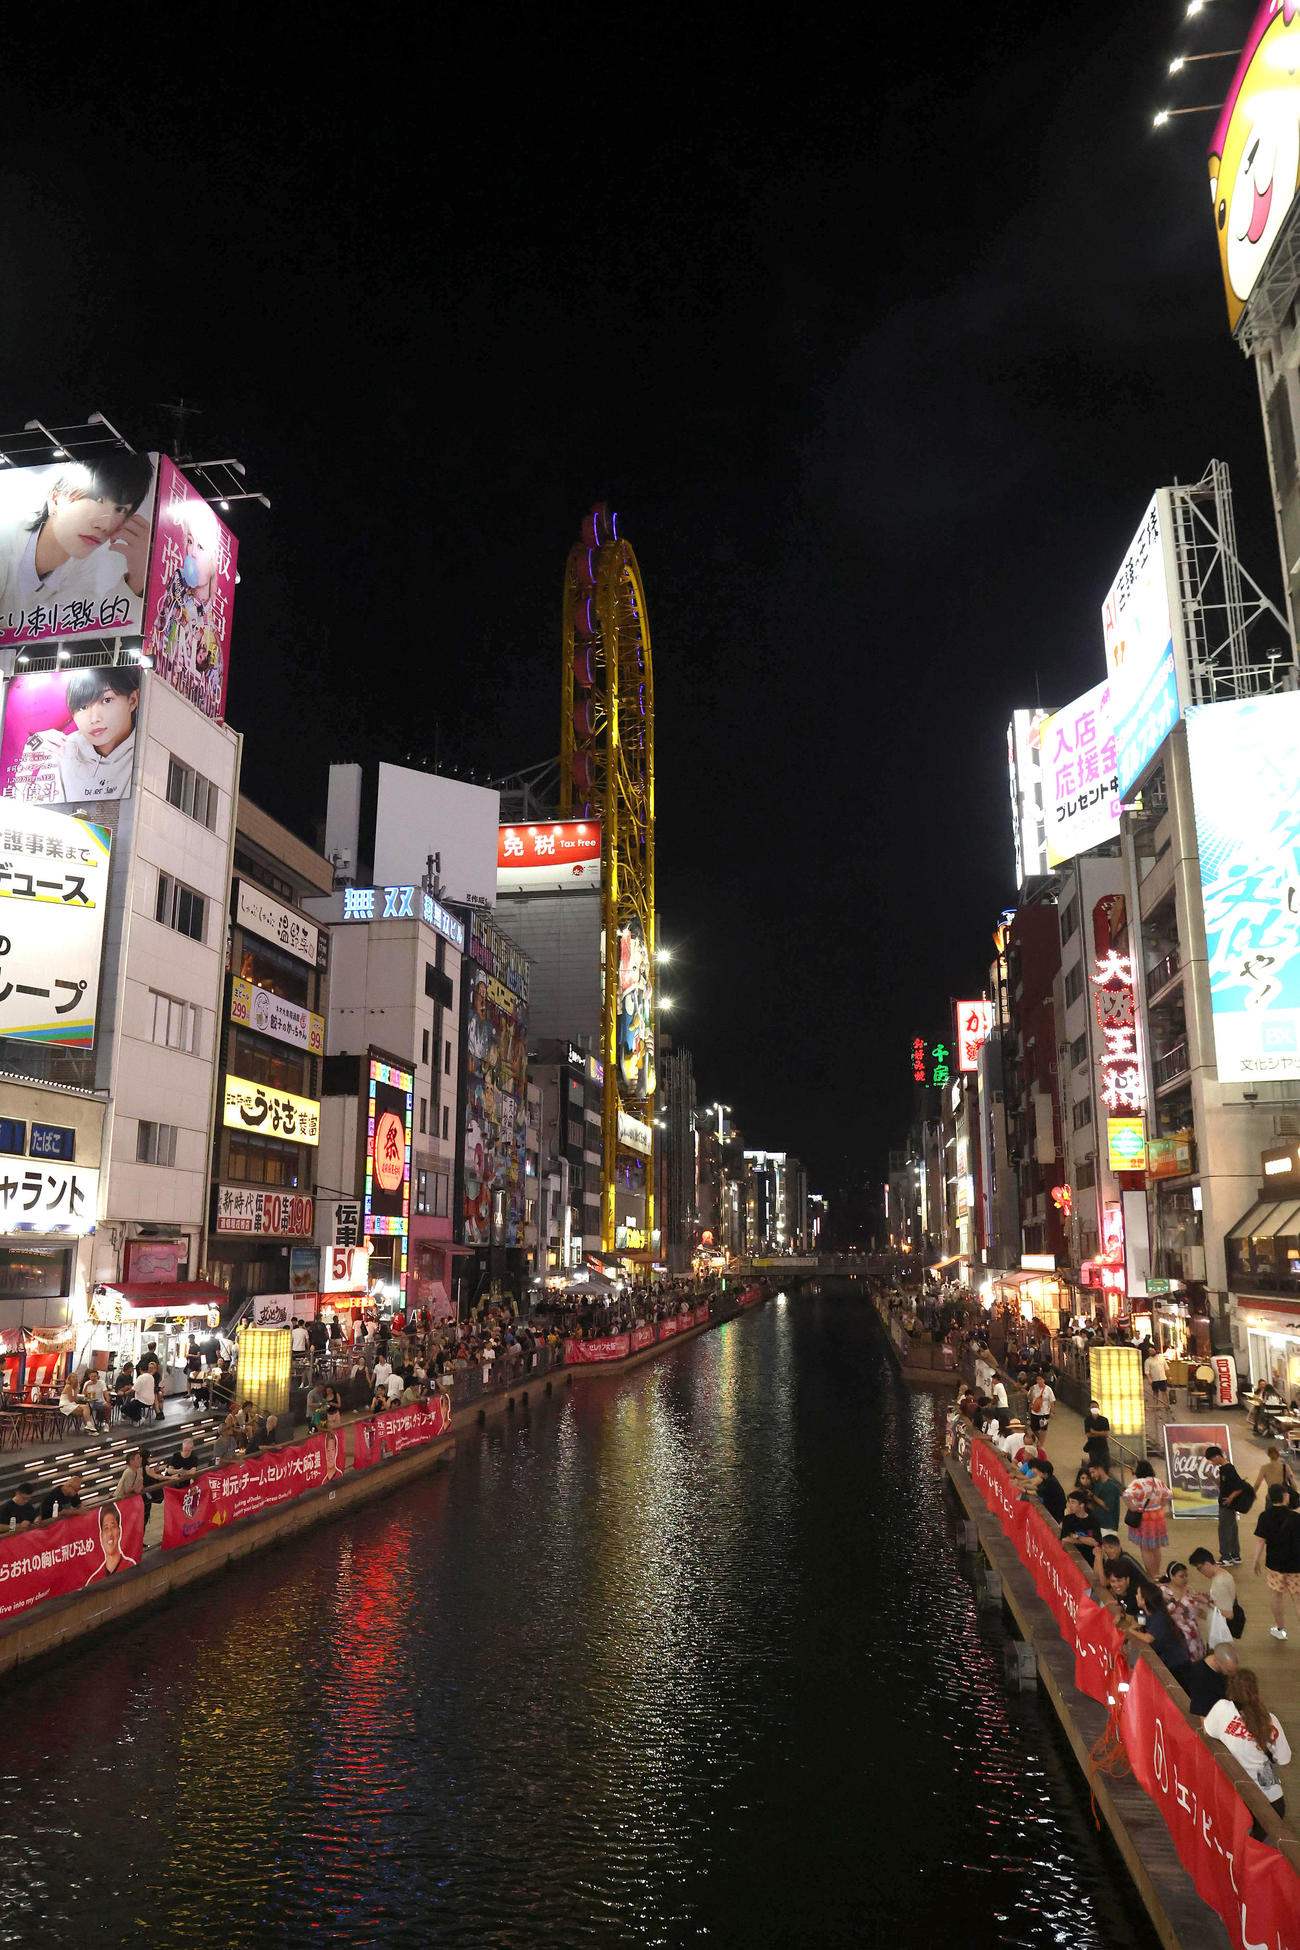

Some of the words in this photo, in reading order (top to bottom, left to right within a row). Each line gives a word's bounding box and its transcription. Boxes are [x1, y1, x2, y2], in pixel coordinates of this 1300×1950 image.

[212, 523, 232, 641] 最高
[1053, 710, 1095, 764] 入店
[1055, 735, 1118, 801] 応援金
[0, 829, 90, 862] 護事業まで
[503, 835, 556, 857] 免税
[560, 840, 575, 848] Tax
[577, 839, 596, 847] Free
[344, 887, 415, 919] 無双
[270, 1014, 307, 1040] 餃子のかっちゃん
[932, 1043, 949, 1082] 千房
[240, 1088, 297, 1134] うなぎ
[32, 1131, 60, 1152] たばこ
[223, 1189, 254, 1216] 新時代
[263, 1195, 281, 1232] 50
[288, 1195, 313, 1234] 190
[335, 1204, 358, 1247] 伝串
[1173, 1450, 1227, 1480] Coca-Co
